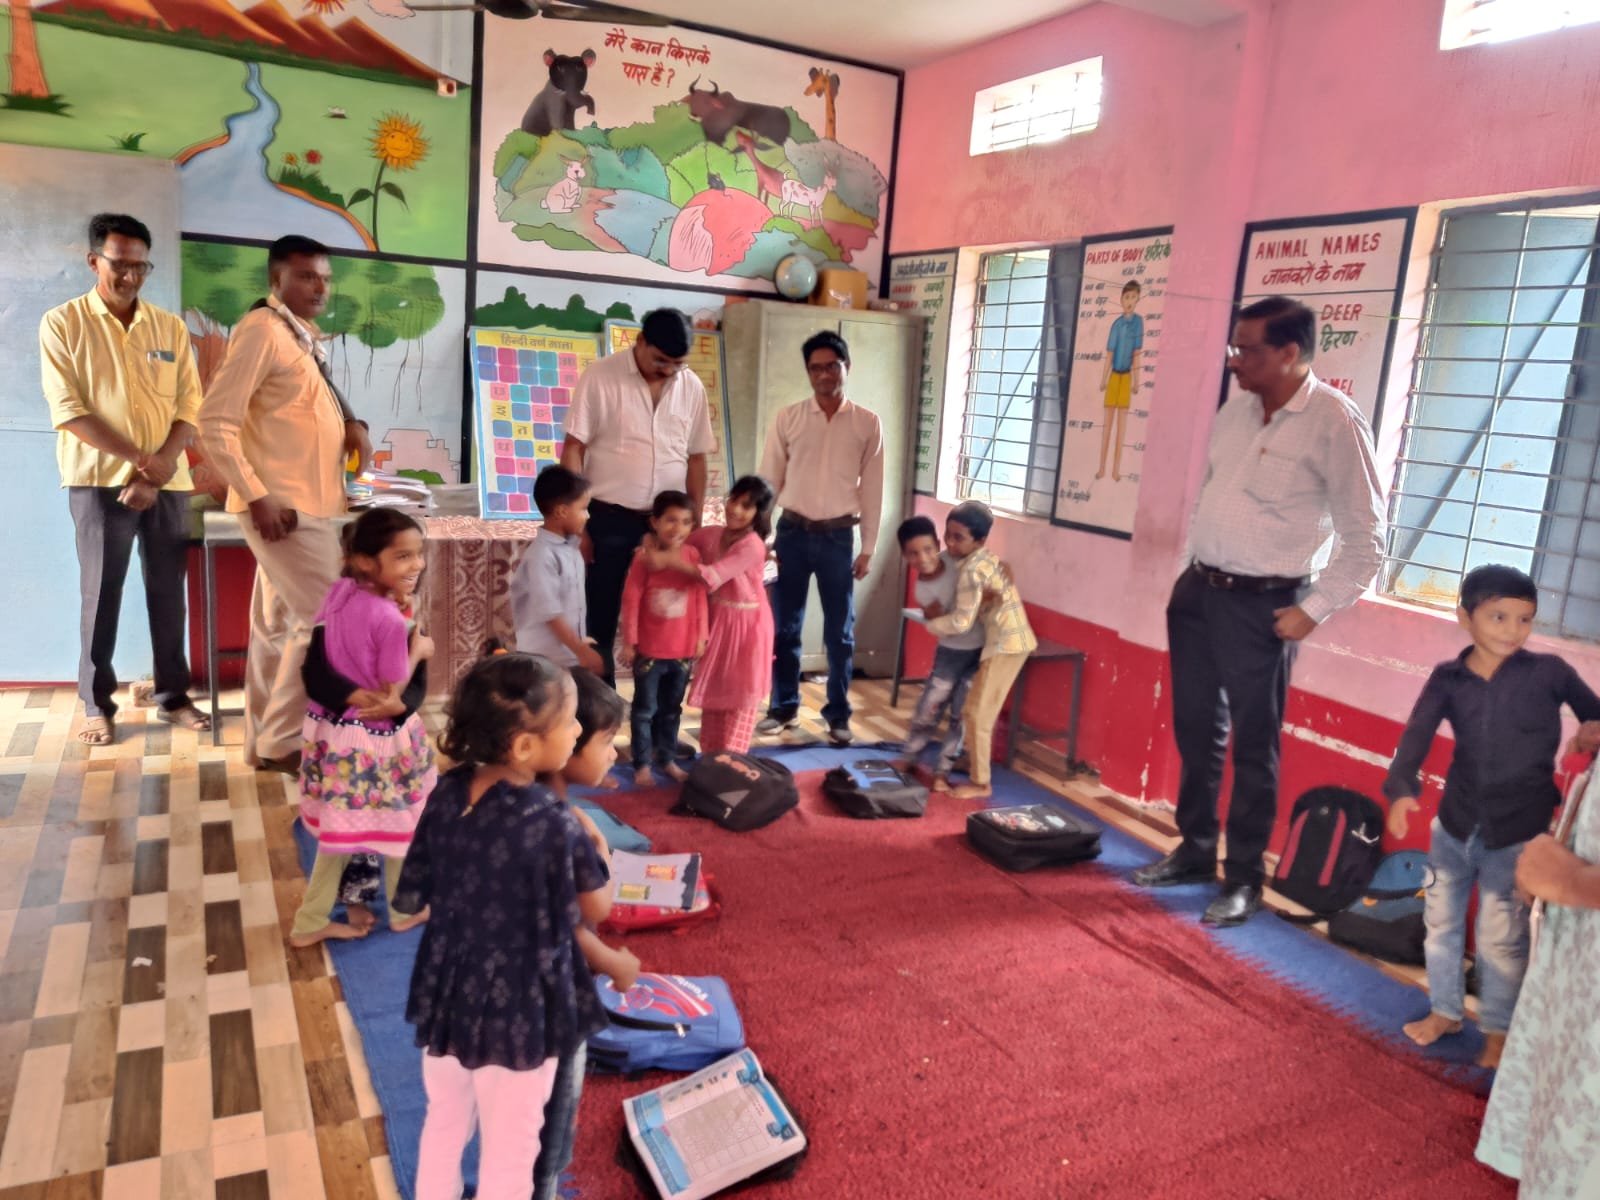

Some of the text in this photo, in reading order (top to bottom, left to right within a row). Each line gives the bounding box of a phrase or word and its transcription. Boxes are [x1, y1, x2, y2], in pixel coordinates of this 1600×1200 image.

[604, 28, 711, 67] मेरे कान किसके
[622, 62, 651, 86] पास
[1086, 248, 1145, 264] PARTS OF BODY
[1255, 233, 1381, 260] ANIMAL NAMES
[1315, 260, 1333, 282] के
[1332, 262, 1367, 283] नाम
[1321, 304, 1362, 321] DEER
[619, 330, 630, 347] A
[700, 337, 711, 355] E
[1320, 324, 1358, 352] हिरण
